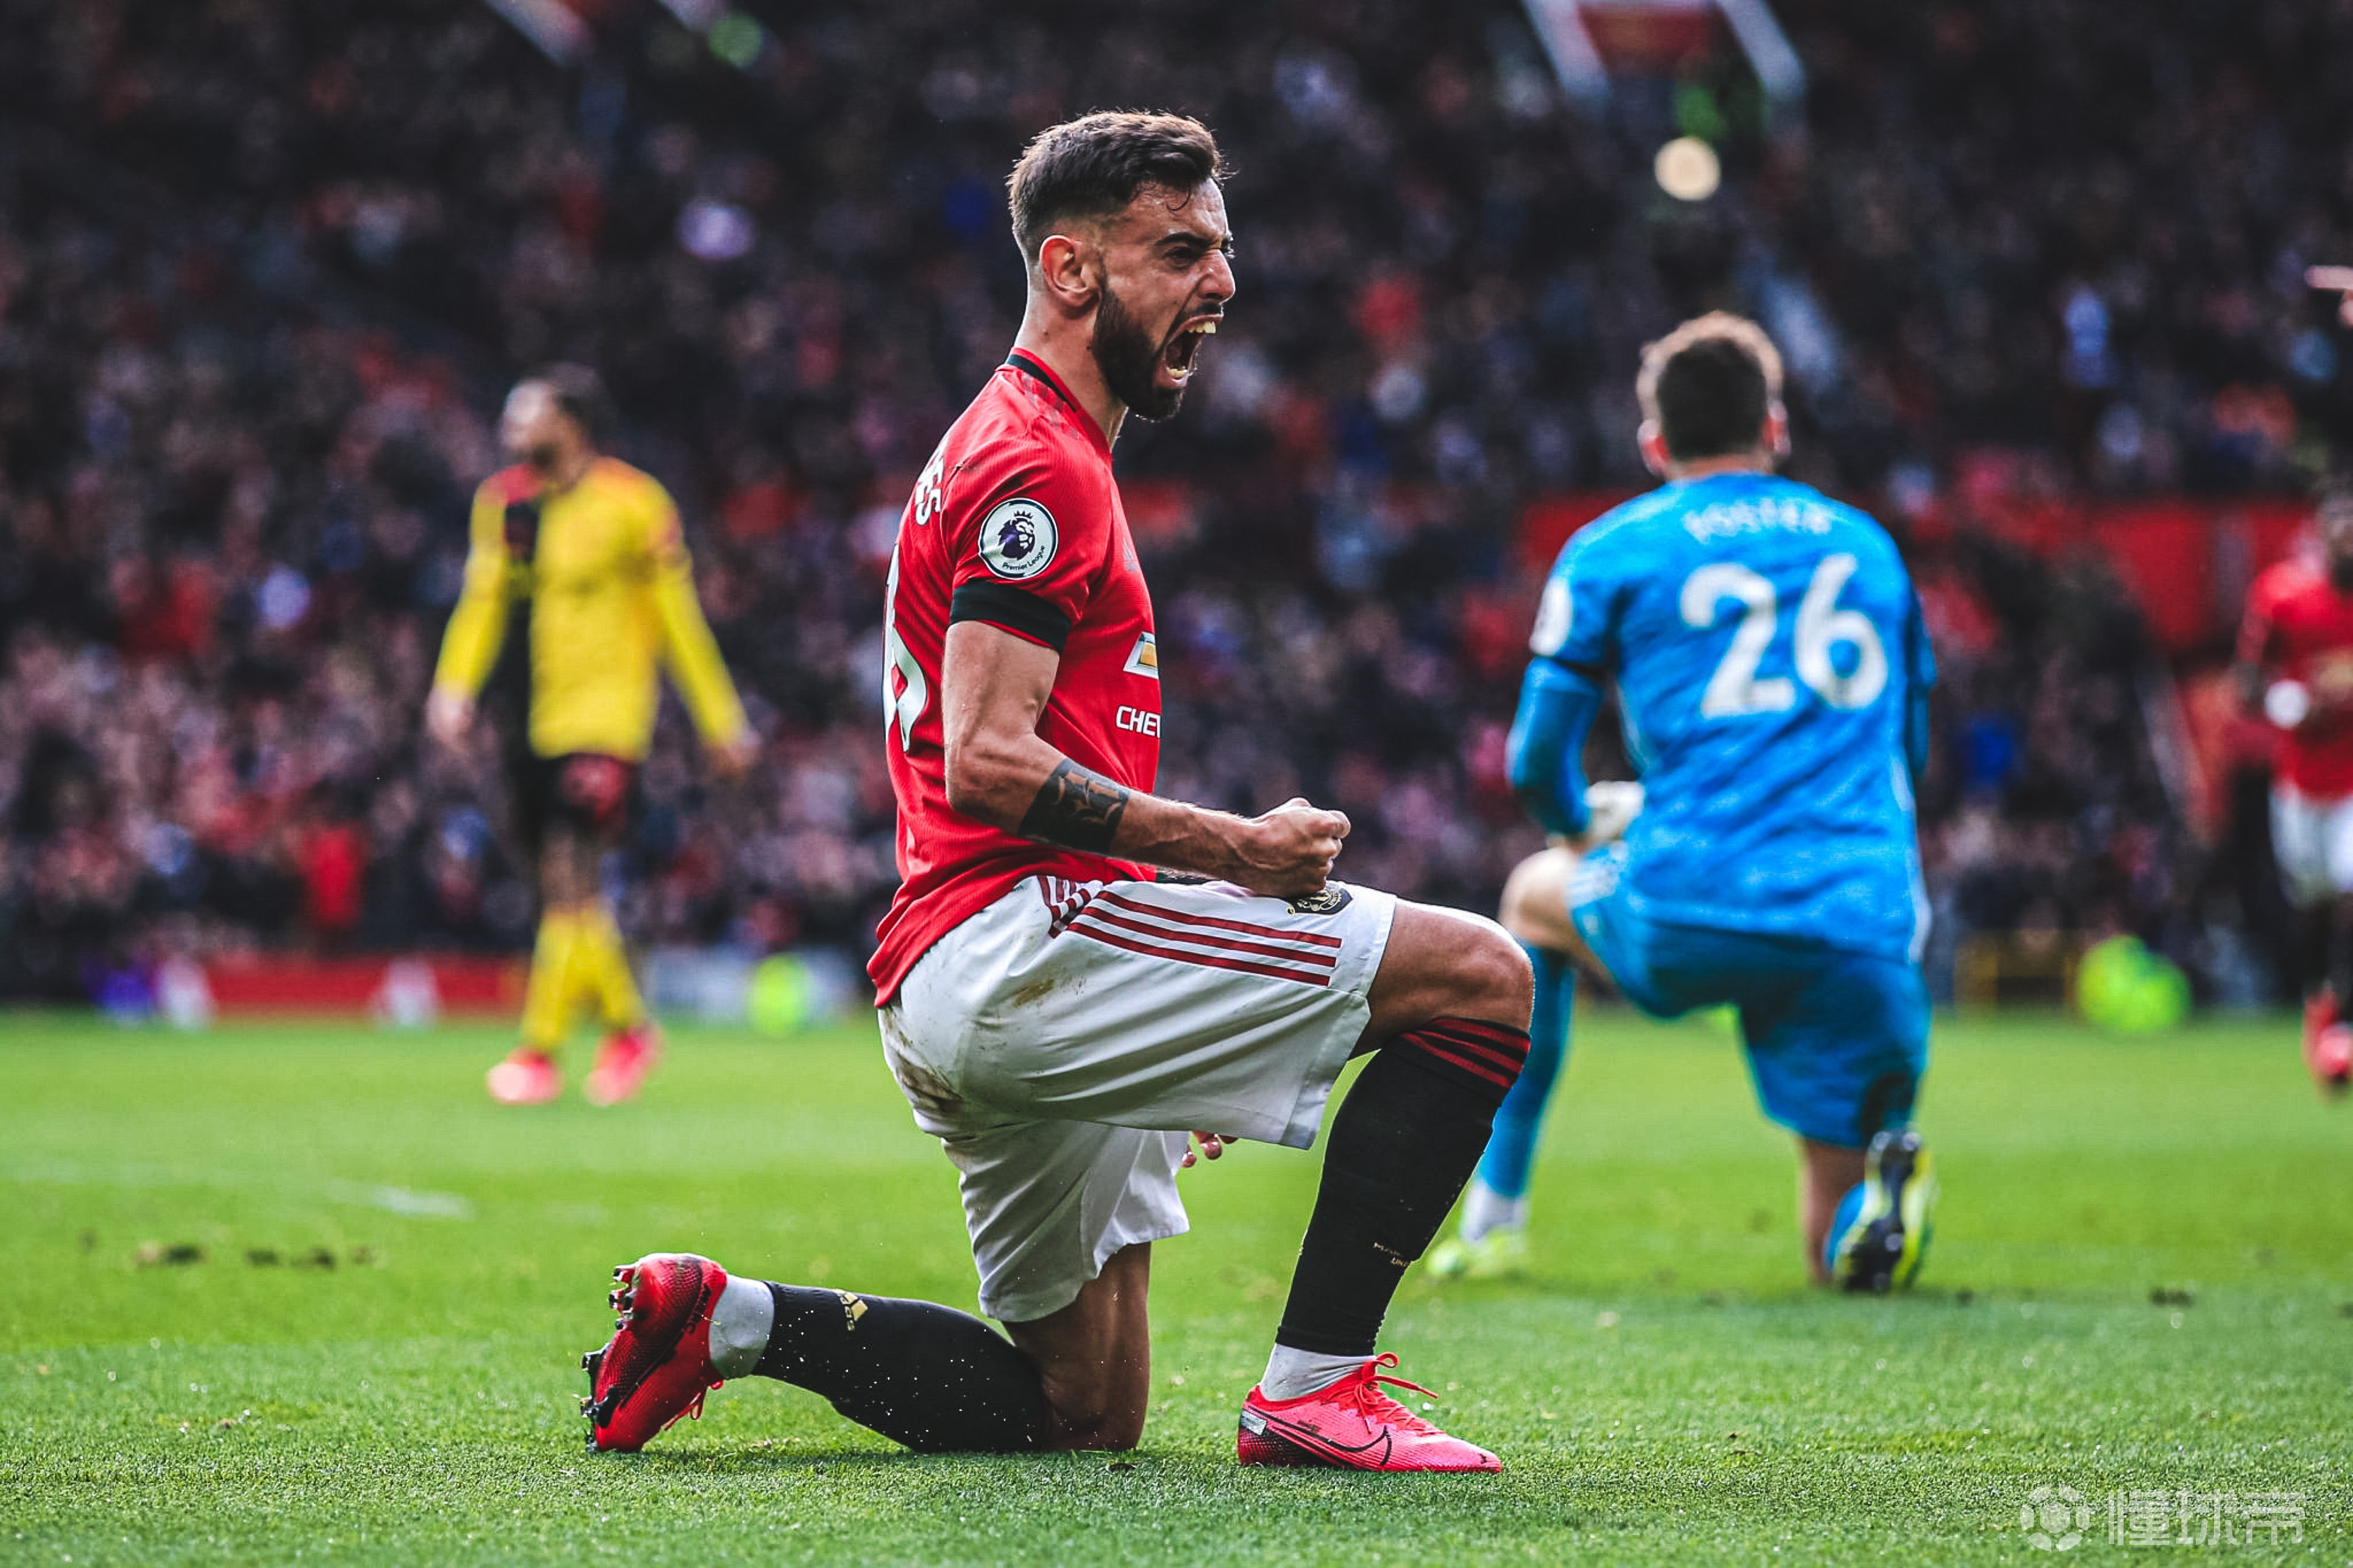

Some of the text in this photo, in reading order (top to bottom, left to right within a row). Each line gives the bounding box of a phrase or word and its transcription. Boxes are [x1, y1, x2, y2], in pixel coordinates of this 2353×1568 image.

[1002, 545, 1045, 570] Premier League
[1681, 553, 1888, 718] 26
